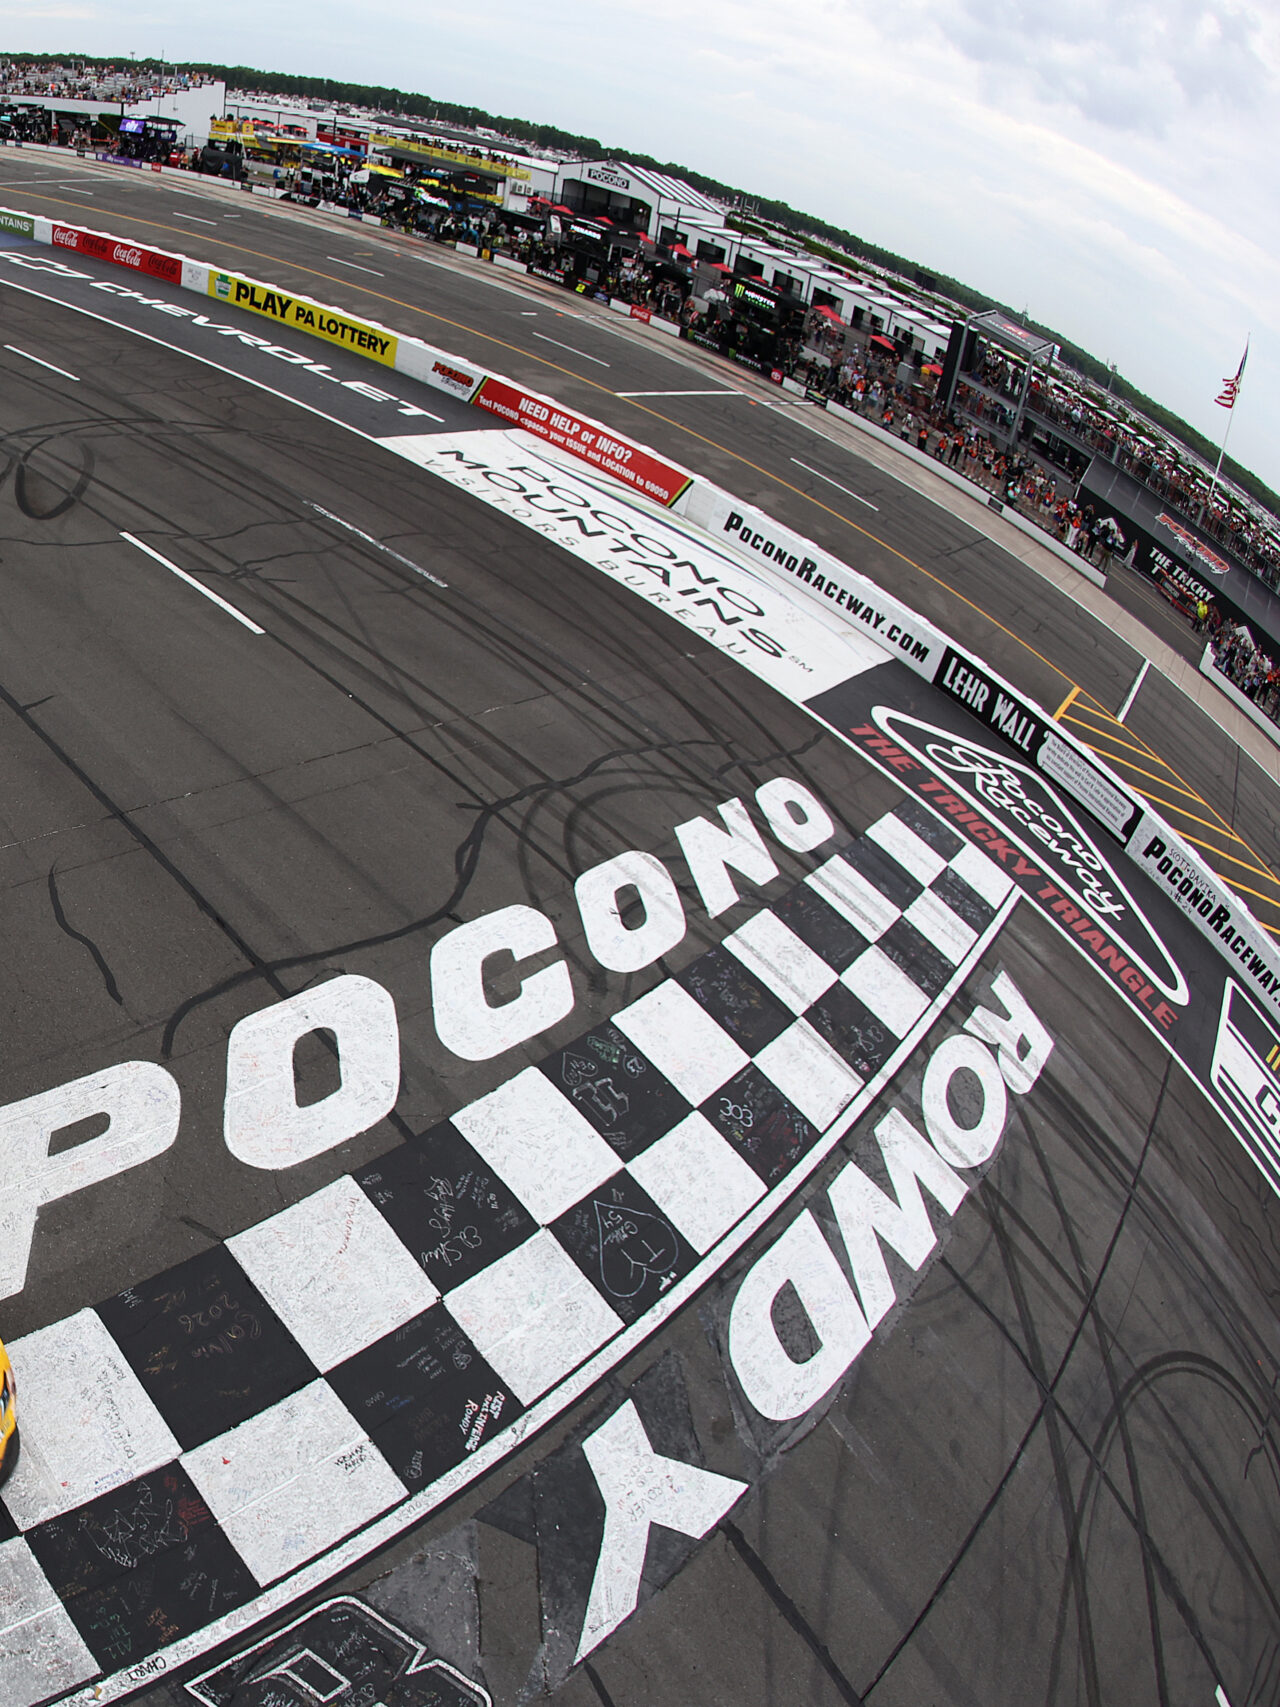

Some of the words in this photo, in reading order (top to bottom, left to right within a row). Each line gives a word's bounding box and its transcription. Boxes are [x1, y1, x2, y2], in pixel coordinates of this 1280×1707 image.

[590, 169, 628, 188] POCONO
[53, 227, 78, 248] Coca-Cola
[113, 244, 143, 267] Coca-Cola
[235, 280, 292, 319] PLAY
[295, 304, 316, 328] PA
[318, 313, 390, 356] LOTTERY
[88, 281, 446, 423] CHEVROLET
[478, 394, 493, 410] Text
[492, 401, 519, 422] POCONO
[519, 416, 549, 436] <space>
[548, 429, 566, 446] your
[565, 434, 587, 455] ISSUE
[586, 446, 601, 464] and
[601, 454, 636, 482] LOCATION
[635, 473, 645, 488] to
[644, 478, 670, 501] 69050
[518, 397, 550, 422] NEED
[550, 413, 581, 437] HELP
[580, 428, 597, 443] or
[596, 434, 633, 464] INFO?
[422, 457, 581, 550] VISITORS
[595, 558, 753, 658] BUREAU
[436, 449, 788, 659] MOUNTAINS
[508, 465, 767, 619] POCONO
[1148, 546, 1174, 571] THE
[1171, 564, 1216, 602] TRICKY
[1155, 512, 1229, 572] POCONO
[941, 656, 987, 715] LEHR
[990, 692, 1039, 752] WALL
[849, 722, 922, 774] THE
[918, 776, 1041, 877] TRICKY
[1036, 880, 1180, 1030] TRIANGLE
[720, 1097, 754, 1128] 303
[602, 1209, 623, 1230] 54
[573, 970, 1056, 1668] ROWDY
[459, 1399, 481, 1436] ROWDY
[489, 1390, 506, 1421] REST
